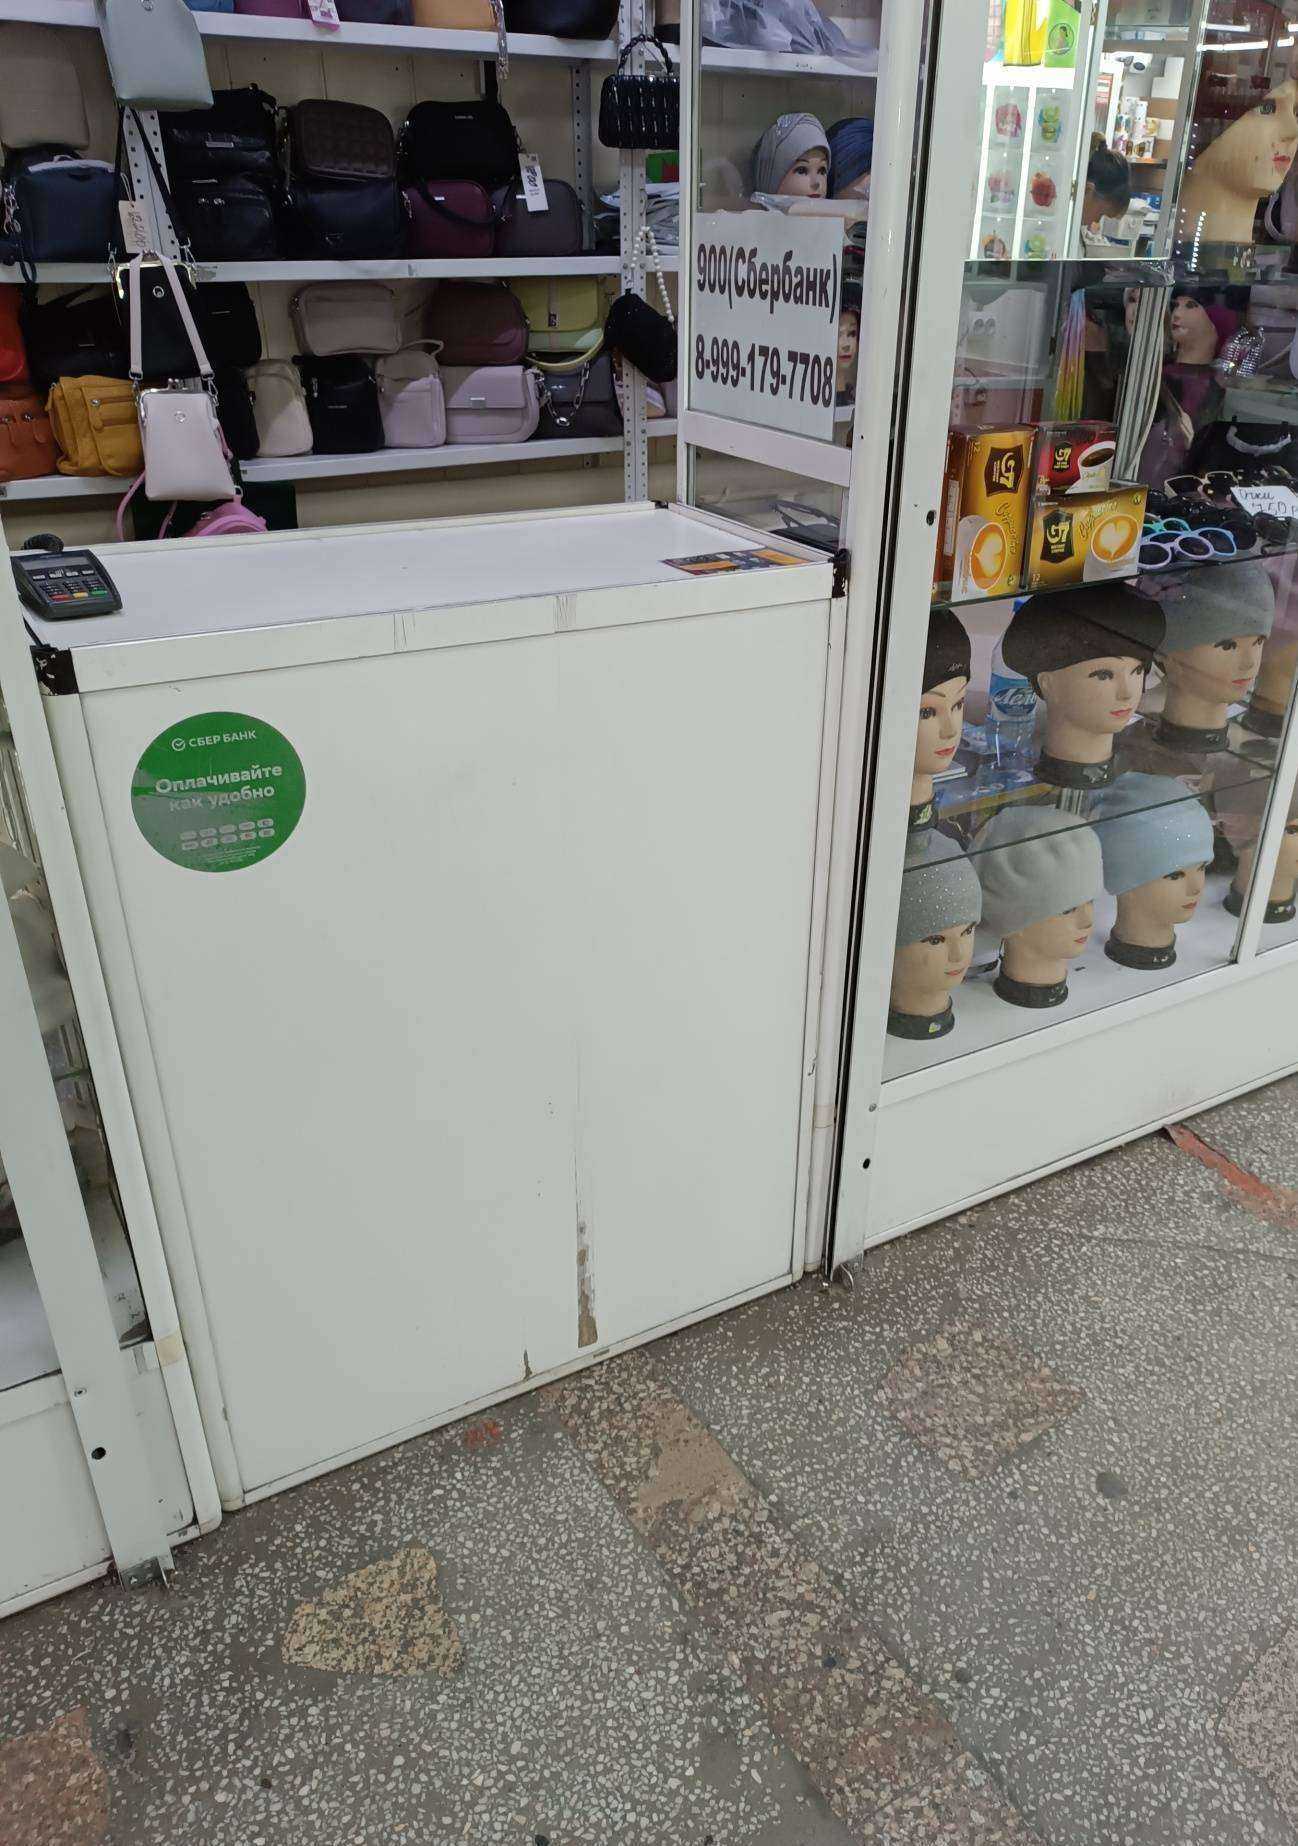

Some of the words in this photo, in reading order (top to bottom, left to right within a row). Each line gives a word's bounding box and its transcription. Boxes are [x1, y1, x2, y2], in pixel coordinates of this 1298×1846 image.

[696, 243, 838, 323] 900(Сбербанк)
[696, 334, 834, 408] 8-999-179-7708
[1055, 446, 1072, 462] G7
[1001, 451, 1015, 489] G7
[1046, 521, 1070, 544] G7
[155, 764, 282, 794] Оплачивайте
[169, 796, 204, 812] как
[208, 785, 275, 810] удобно
